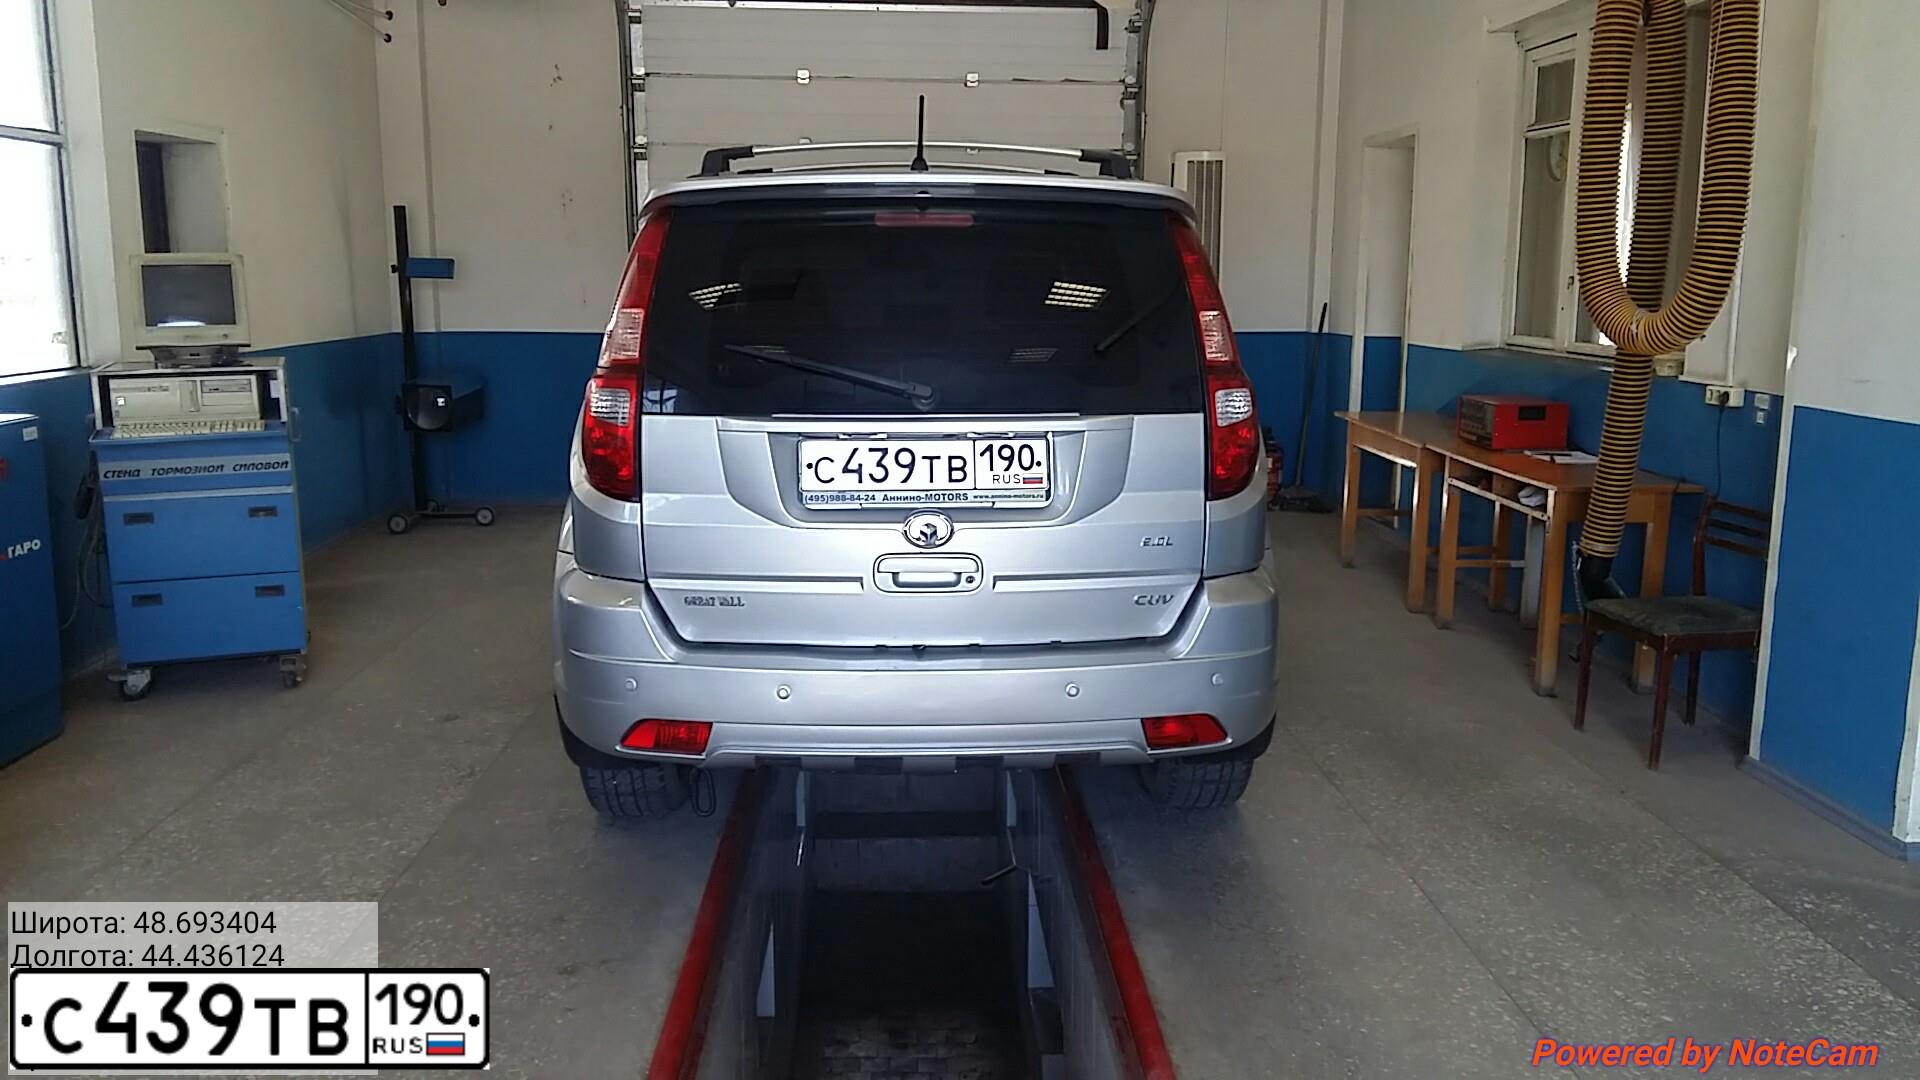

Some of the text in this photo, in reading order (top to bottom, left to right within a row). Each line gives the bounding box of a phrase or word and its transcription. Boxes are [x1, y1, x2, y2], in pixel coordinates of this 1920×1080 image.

[814, 444, 1035, 484] С439ТВ 190
[103, 468, 141, 479] СТЕНД
[992, 474, 1021, 484] RUS
[804, 494, 876, 503] (495)988-84-24
[7, 539, 41, 559] ГАРО
